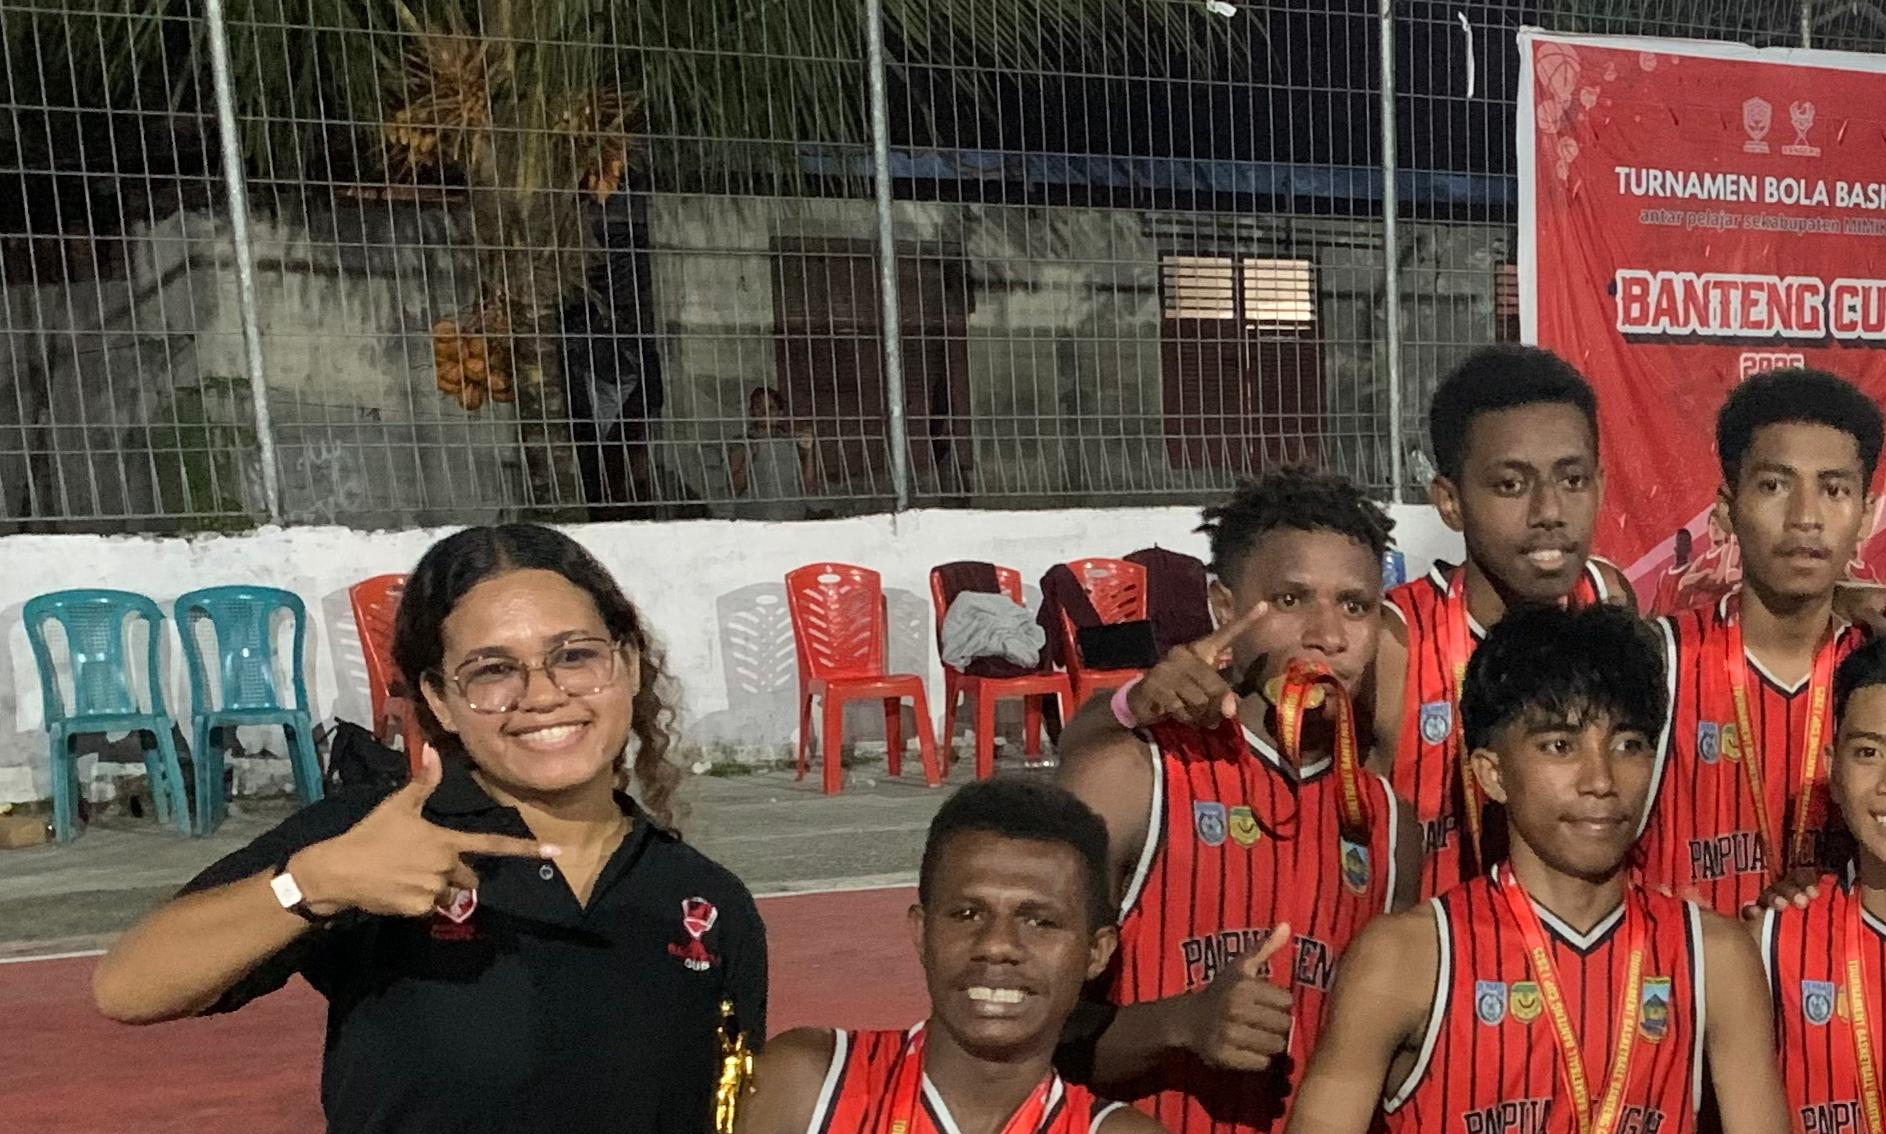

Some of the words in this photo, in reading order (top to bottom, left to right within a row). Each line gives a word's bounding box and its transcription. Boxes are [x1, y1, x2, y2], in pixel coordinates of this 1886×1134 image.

[1615, 166, 1756, 201] TURNAMEN
[1764, 177, 1829, 206] BOLA
[1639, 209, 1682, 225] antar
[1687, 210, 1741, 232] pelajar
[1744, 213, 1840, 236] sekabupaten
[1616, 270, 1825, 337] BANTENG
